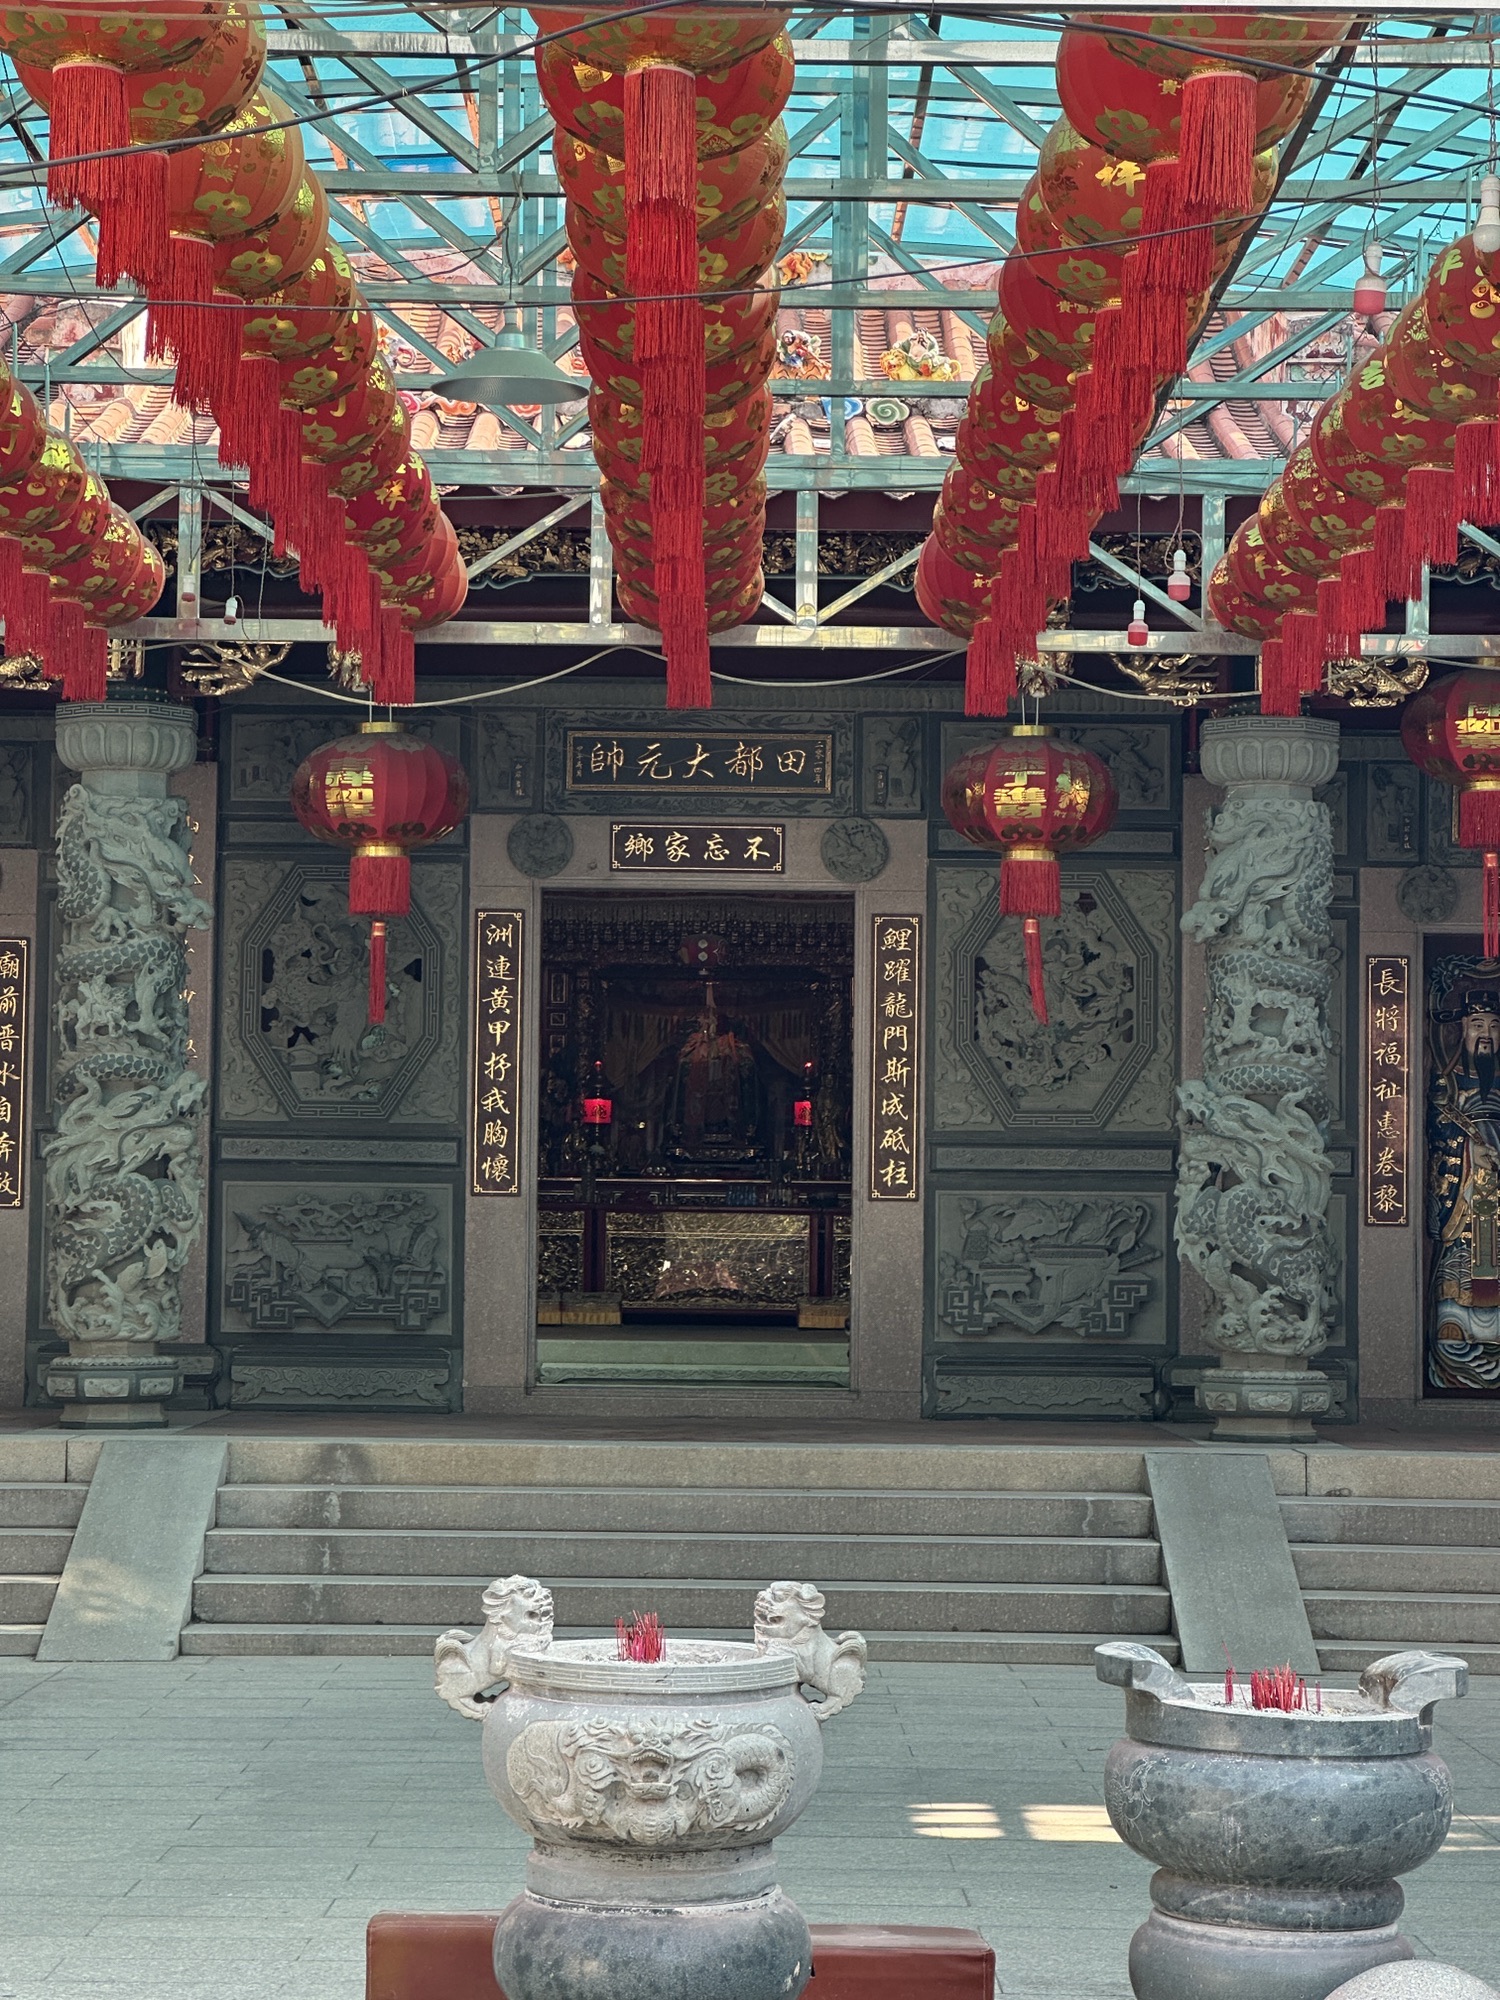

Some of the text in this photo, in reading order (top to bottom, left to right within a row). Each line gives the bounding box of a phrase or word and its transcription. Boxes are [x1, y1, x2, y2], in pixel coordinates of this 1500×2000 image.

[589, 740, 807, 783] 田都大元帥
[624, 830, 771, 863] 不忘家鄉
[879, 927, 913, 1188] 鯉躍龍門斯成砥柱
